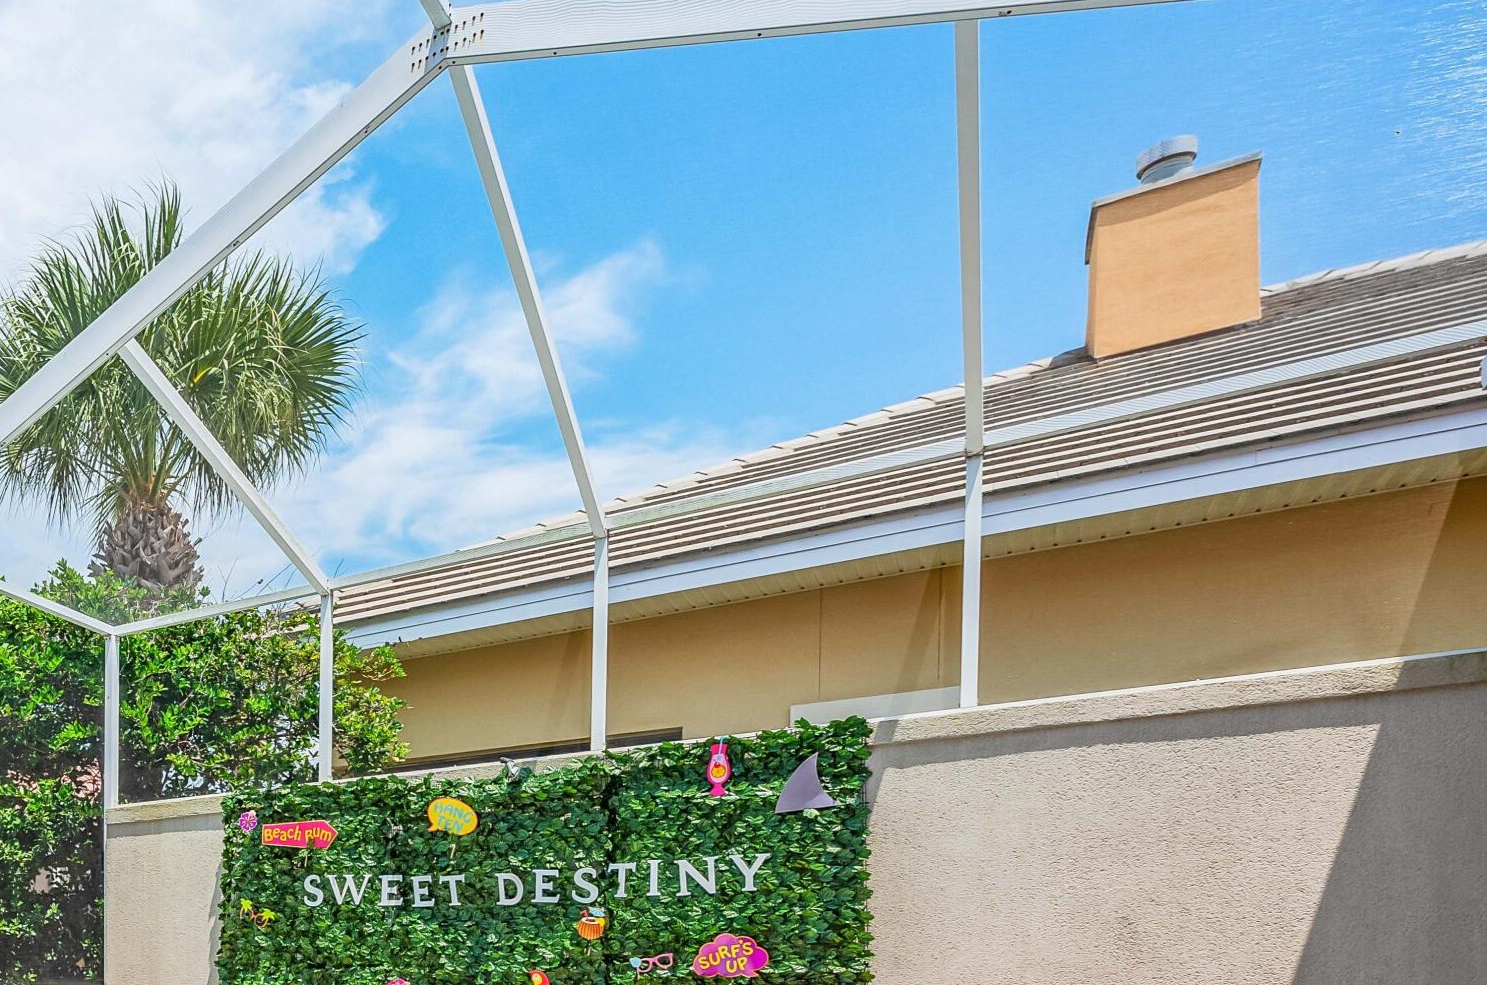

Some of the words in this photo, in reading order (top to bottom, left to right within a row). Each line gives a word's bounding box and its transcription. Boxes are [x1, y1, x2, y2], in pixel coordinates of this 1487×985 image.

[433, 801, 474, 823] HANG
[264, 825, 302, 842] Beach
[437, 814, 463, 833] TEN
[303, 874, 465, 907] SWEET
[494, 853, 771, 906] DESTINY
[698, 939, 754, 970] SURF'S
[725, 956, 748, 973] UP
